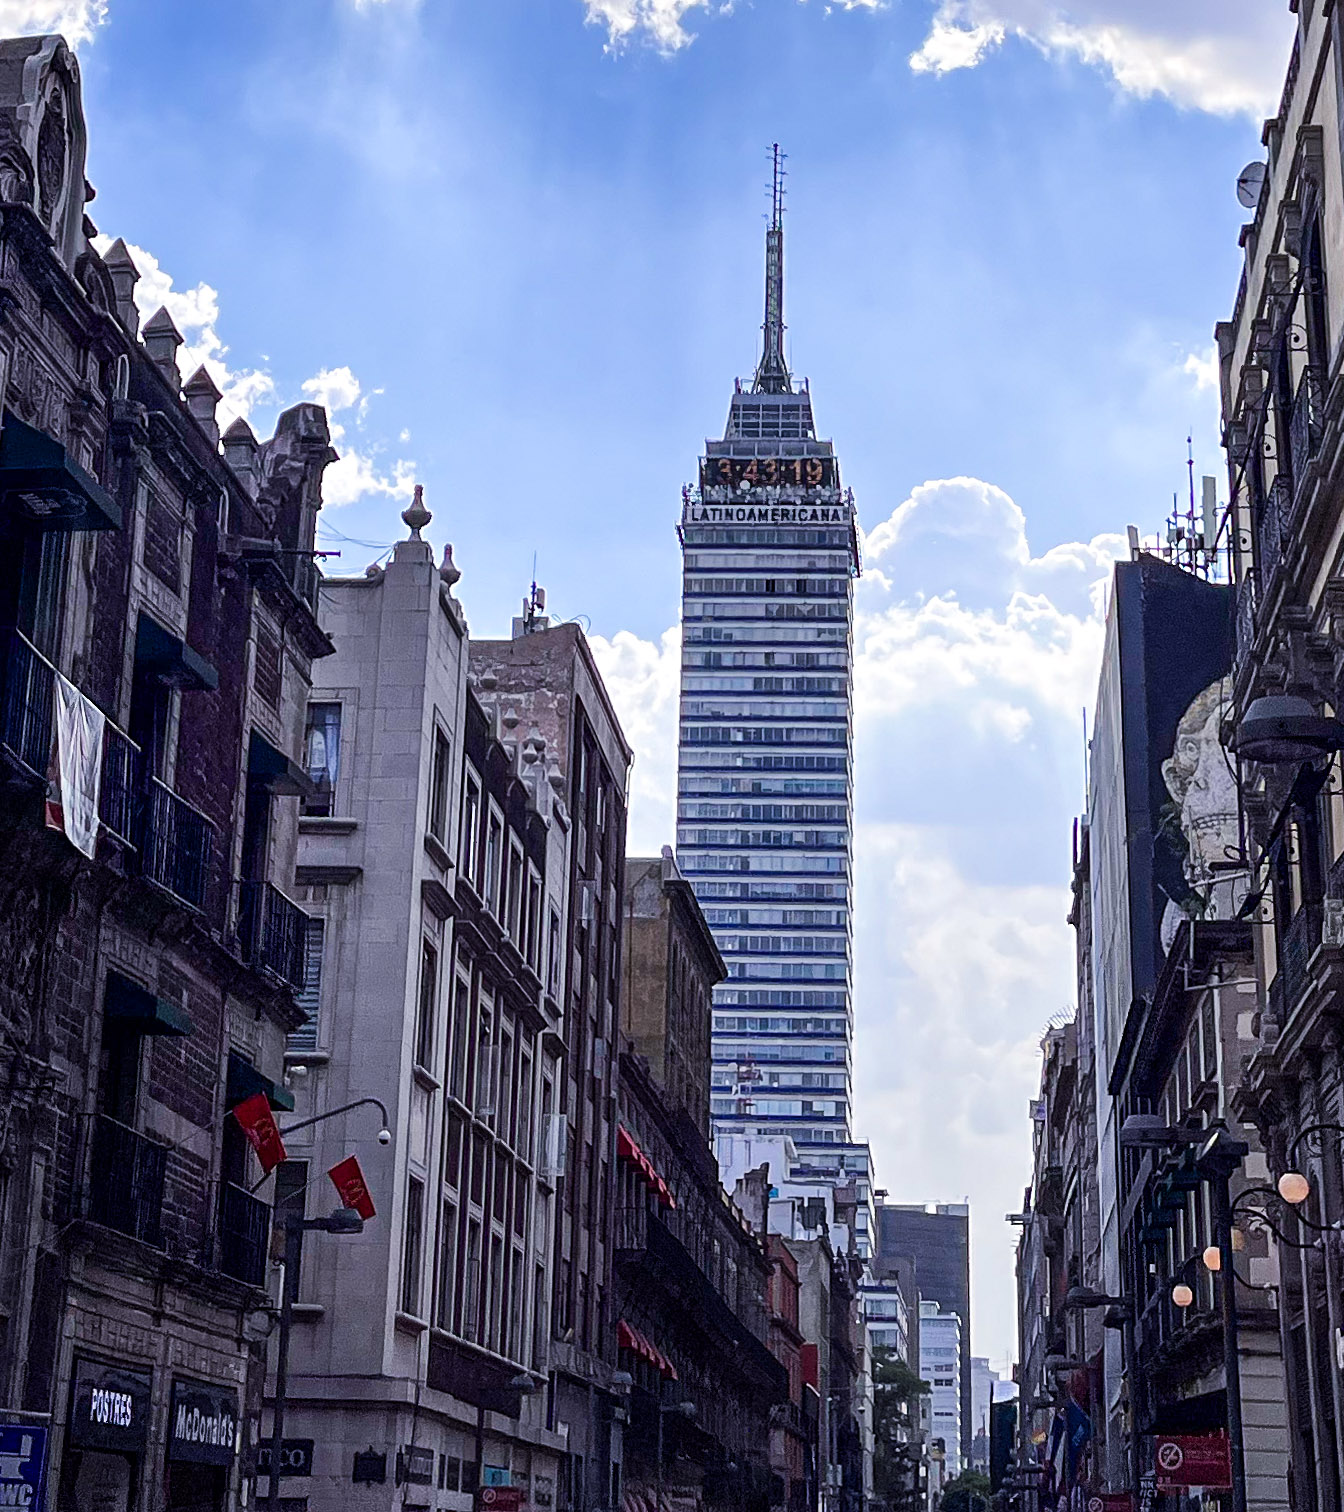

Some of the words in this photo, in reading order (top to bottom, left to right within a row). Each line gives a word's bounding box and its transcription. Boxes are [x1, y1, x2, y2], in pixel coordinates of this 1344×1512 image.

[691, 507, 841, 522] LATINOAMERICANA
[90, 1387, 133, 1428] POSTRES
[175, 1404, 234, 1448] McDonald's
[0, 1483, 33, 1506] WC
